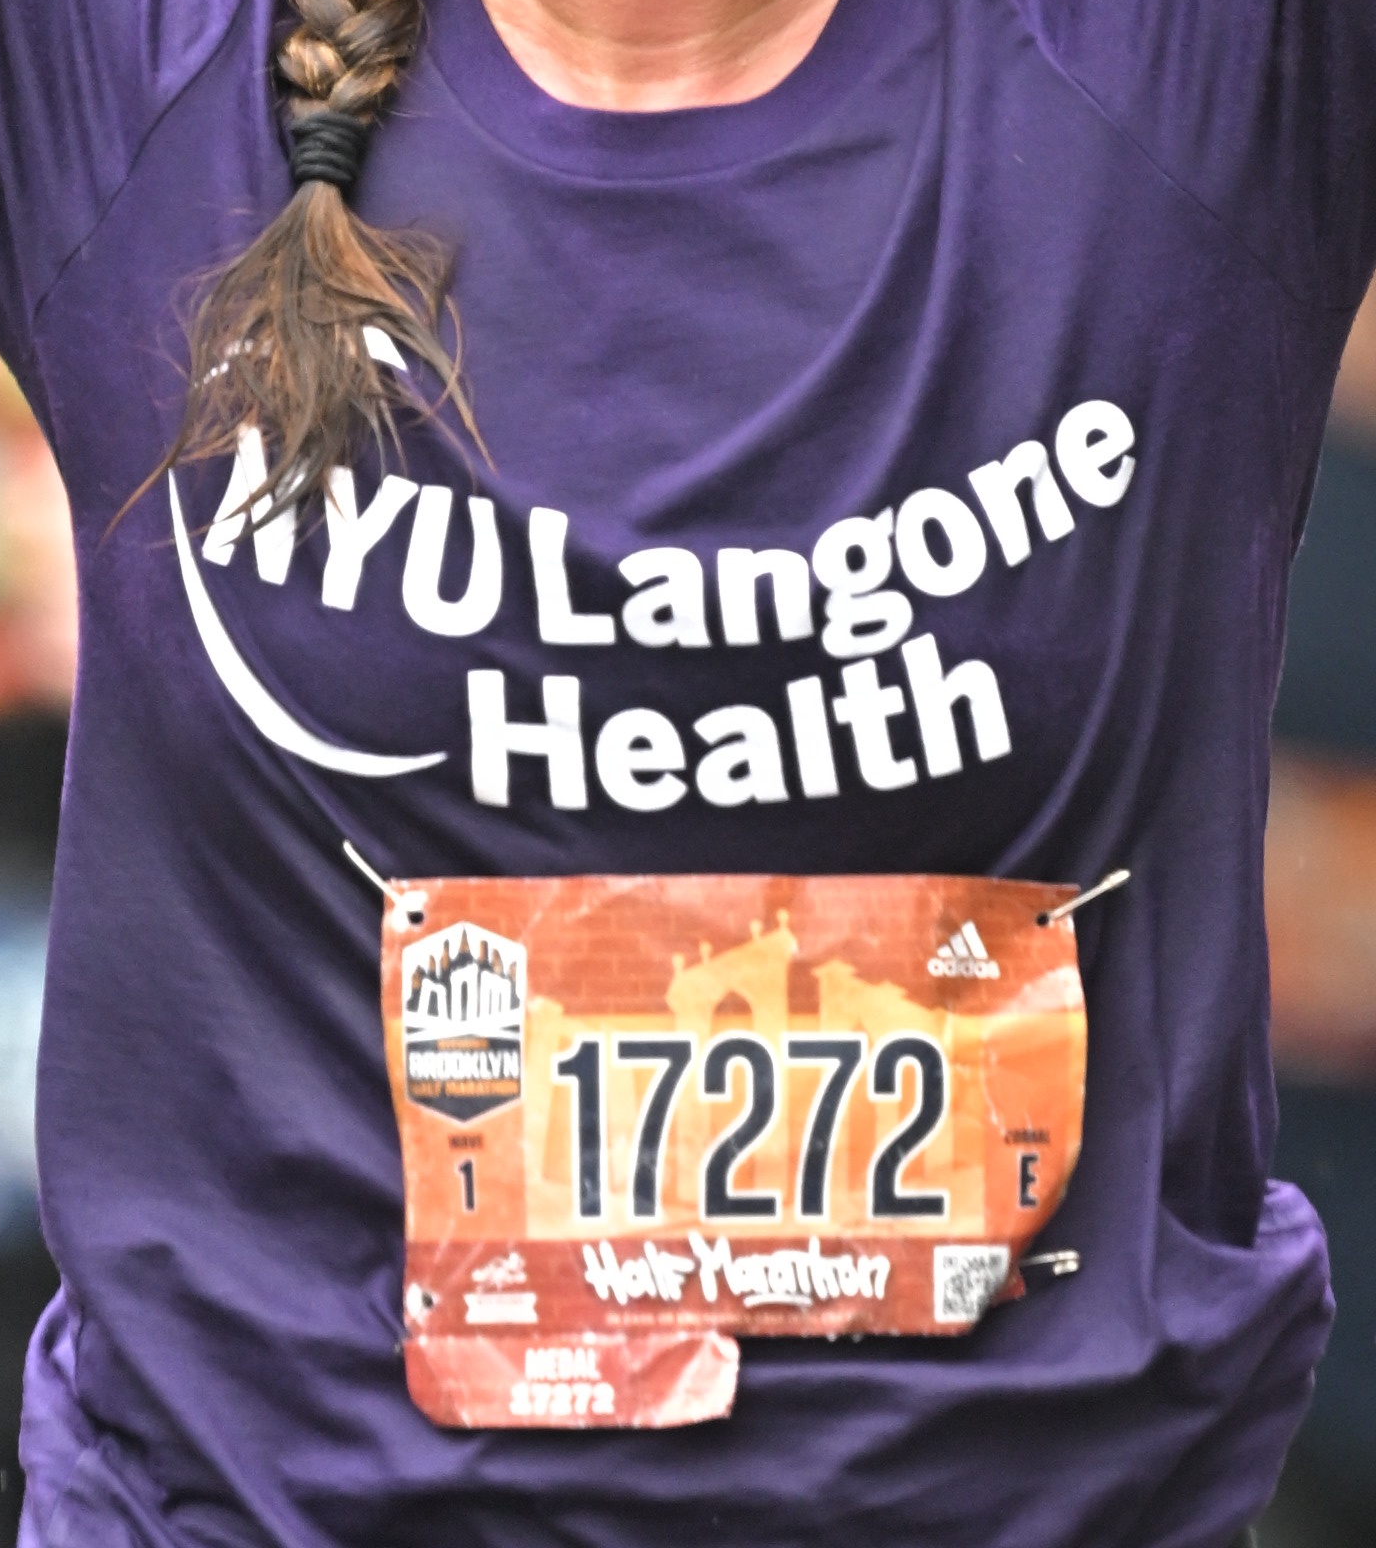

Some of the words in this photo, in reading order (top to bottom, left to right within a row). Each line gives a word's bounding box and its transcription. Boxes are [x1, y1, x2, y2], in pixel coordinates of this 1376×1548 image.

[200, 424, 505, 638] NYU
[528, 398, 1136, 660] Langone
[466, 632, 1012, 813] Health
[927, 956, 1001, 980] adidas
[409, 1050, 520, 1080] BROOKLYN
[554, 1038, 947, 1220] 17272
[458, 1158, 475, 1211] 1
[1019, 1154, 1039, 1207] E
[687, 1229, 891, 1307] Marathon
[524, 1346, 602, 1381] MEDAL
[508, 1381, 616, 1416] 17272
